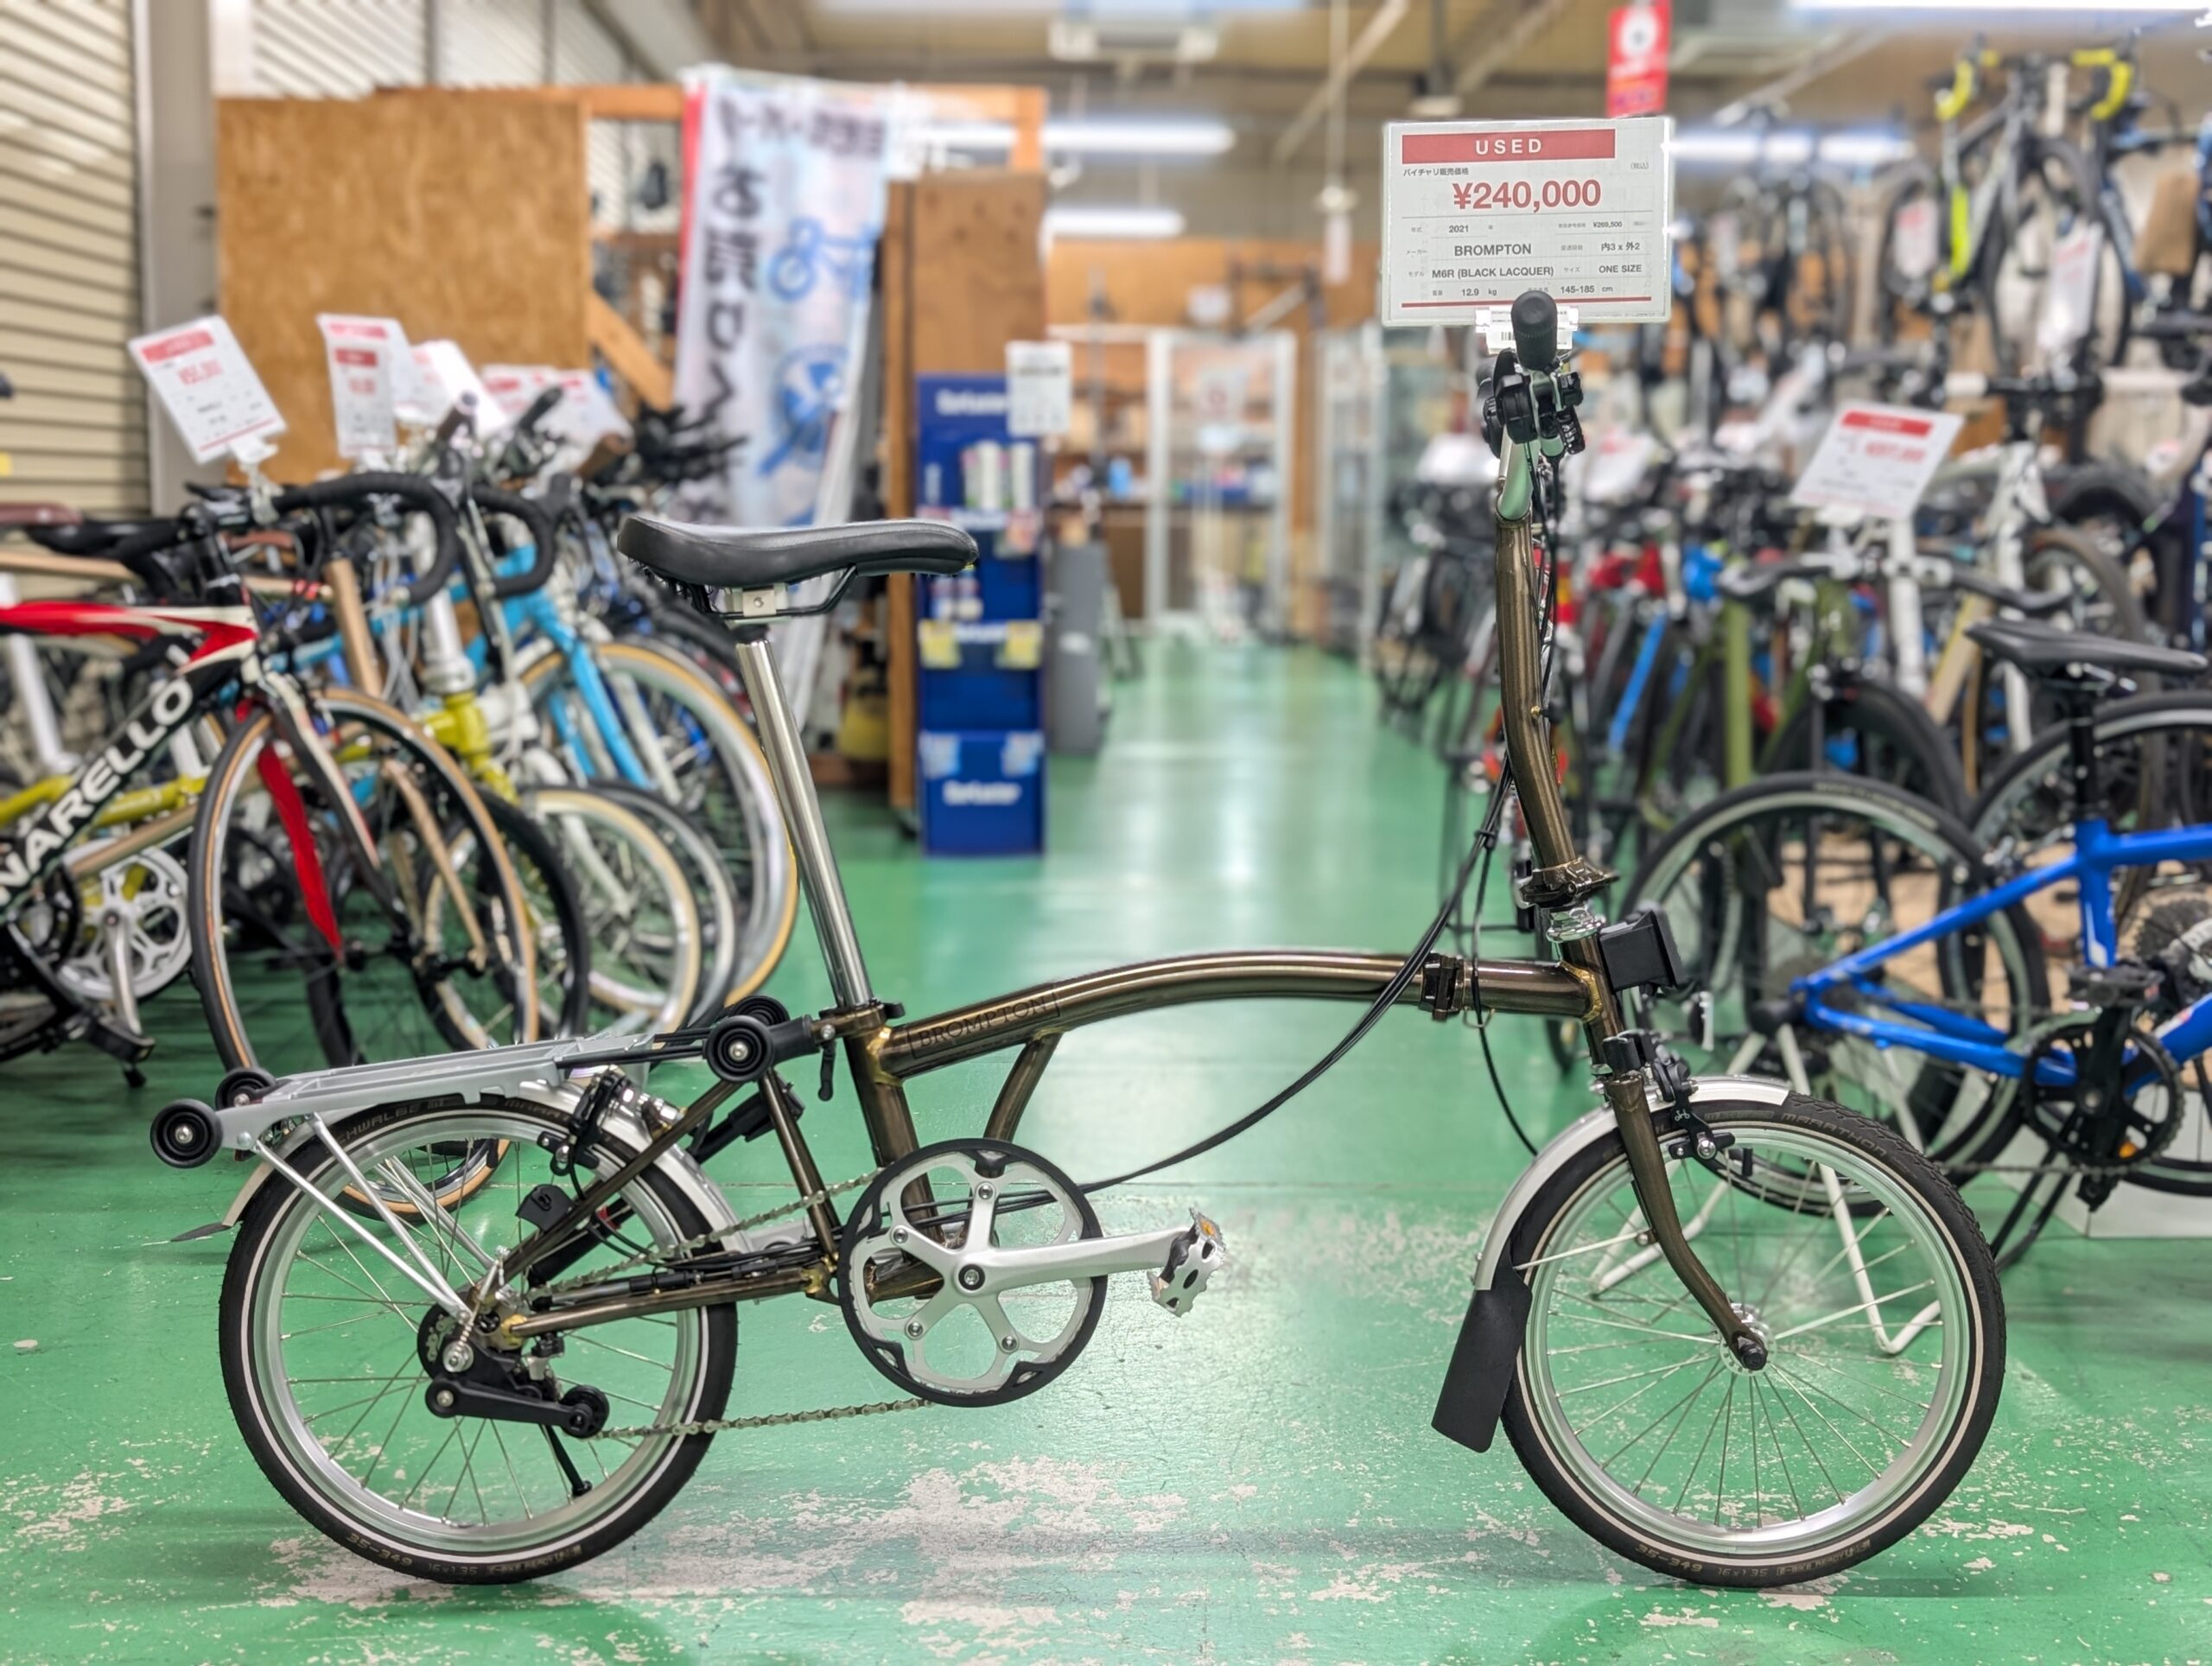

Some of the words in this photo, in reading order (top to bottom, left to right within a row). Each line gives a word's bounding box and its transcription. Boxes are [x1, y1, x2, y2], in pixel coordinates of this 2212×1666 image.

[1475, 138, 1541, 156] USED
[1403, 168, 1469, 176] バイチャリ販売価格
[1452, 179, 1601, 213] ¥240,000
[1449, 225, 1469, 233] 2021
[1454, 243, 1532, 257] BROMPTON
[1601, 243, 1616, 251] 内3
[1625, 242, 1640, 251] 外2
[1432, 269, 1455, 279] M6R
[1458, 268, 1497, 280] (BLACK
[1499, 266, 1554, 277] LACQUER)
[1599, 264, 1619, 274] ONE
[1621, 264, 1643, 273] SIZE
[1461, 288, 1479, 297] 12.9
[1488, 288, 1497, 297] kg
[1560, 285, 1595, 294] 145-185
[917, 996, 1049, 1047] BROMPTON
[1781, 1111, 1888, 1157] MARATHON
[346, 1532, 413, 1567] 35-349
[1635, 1543, 1703, 1573] 35-349
